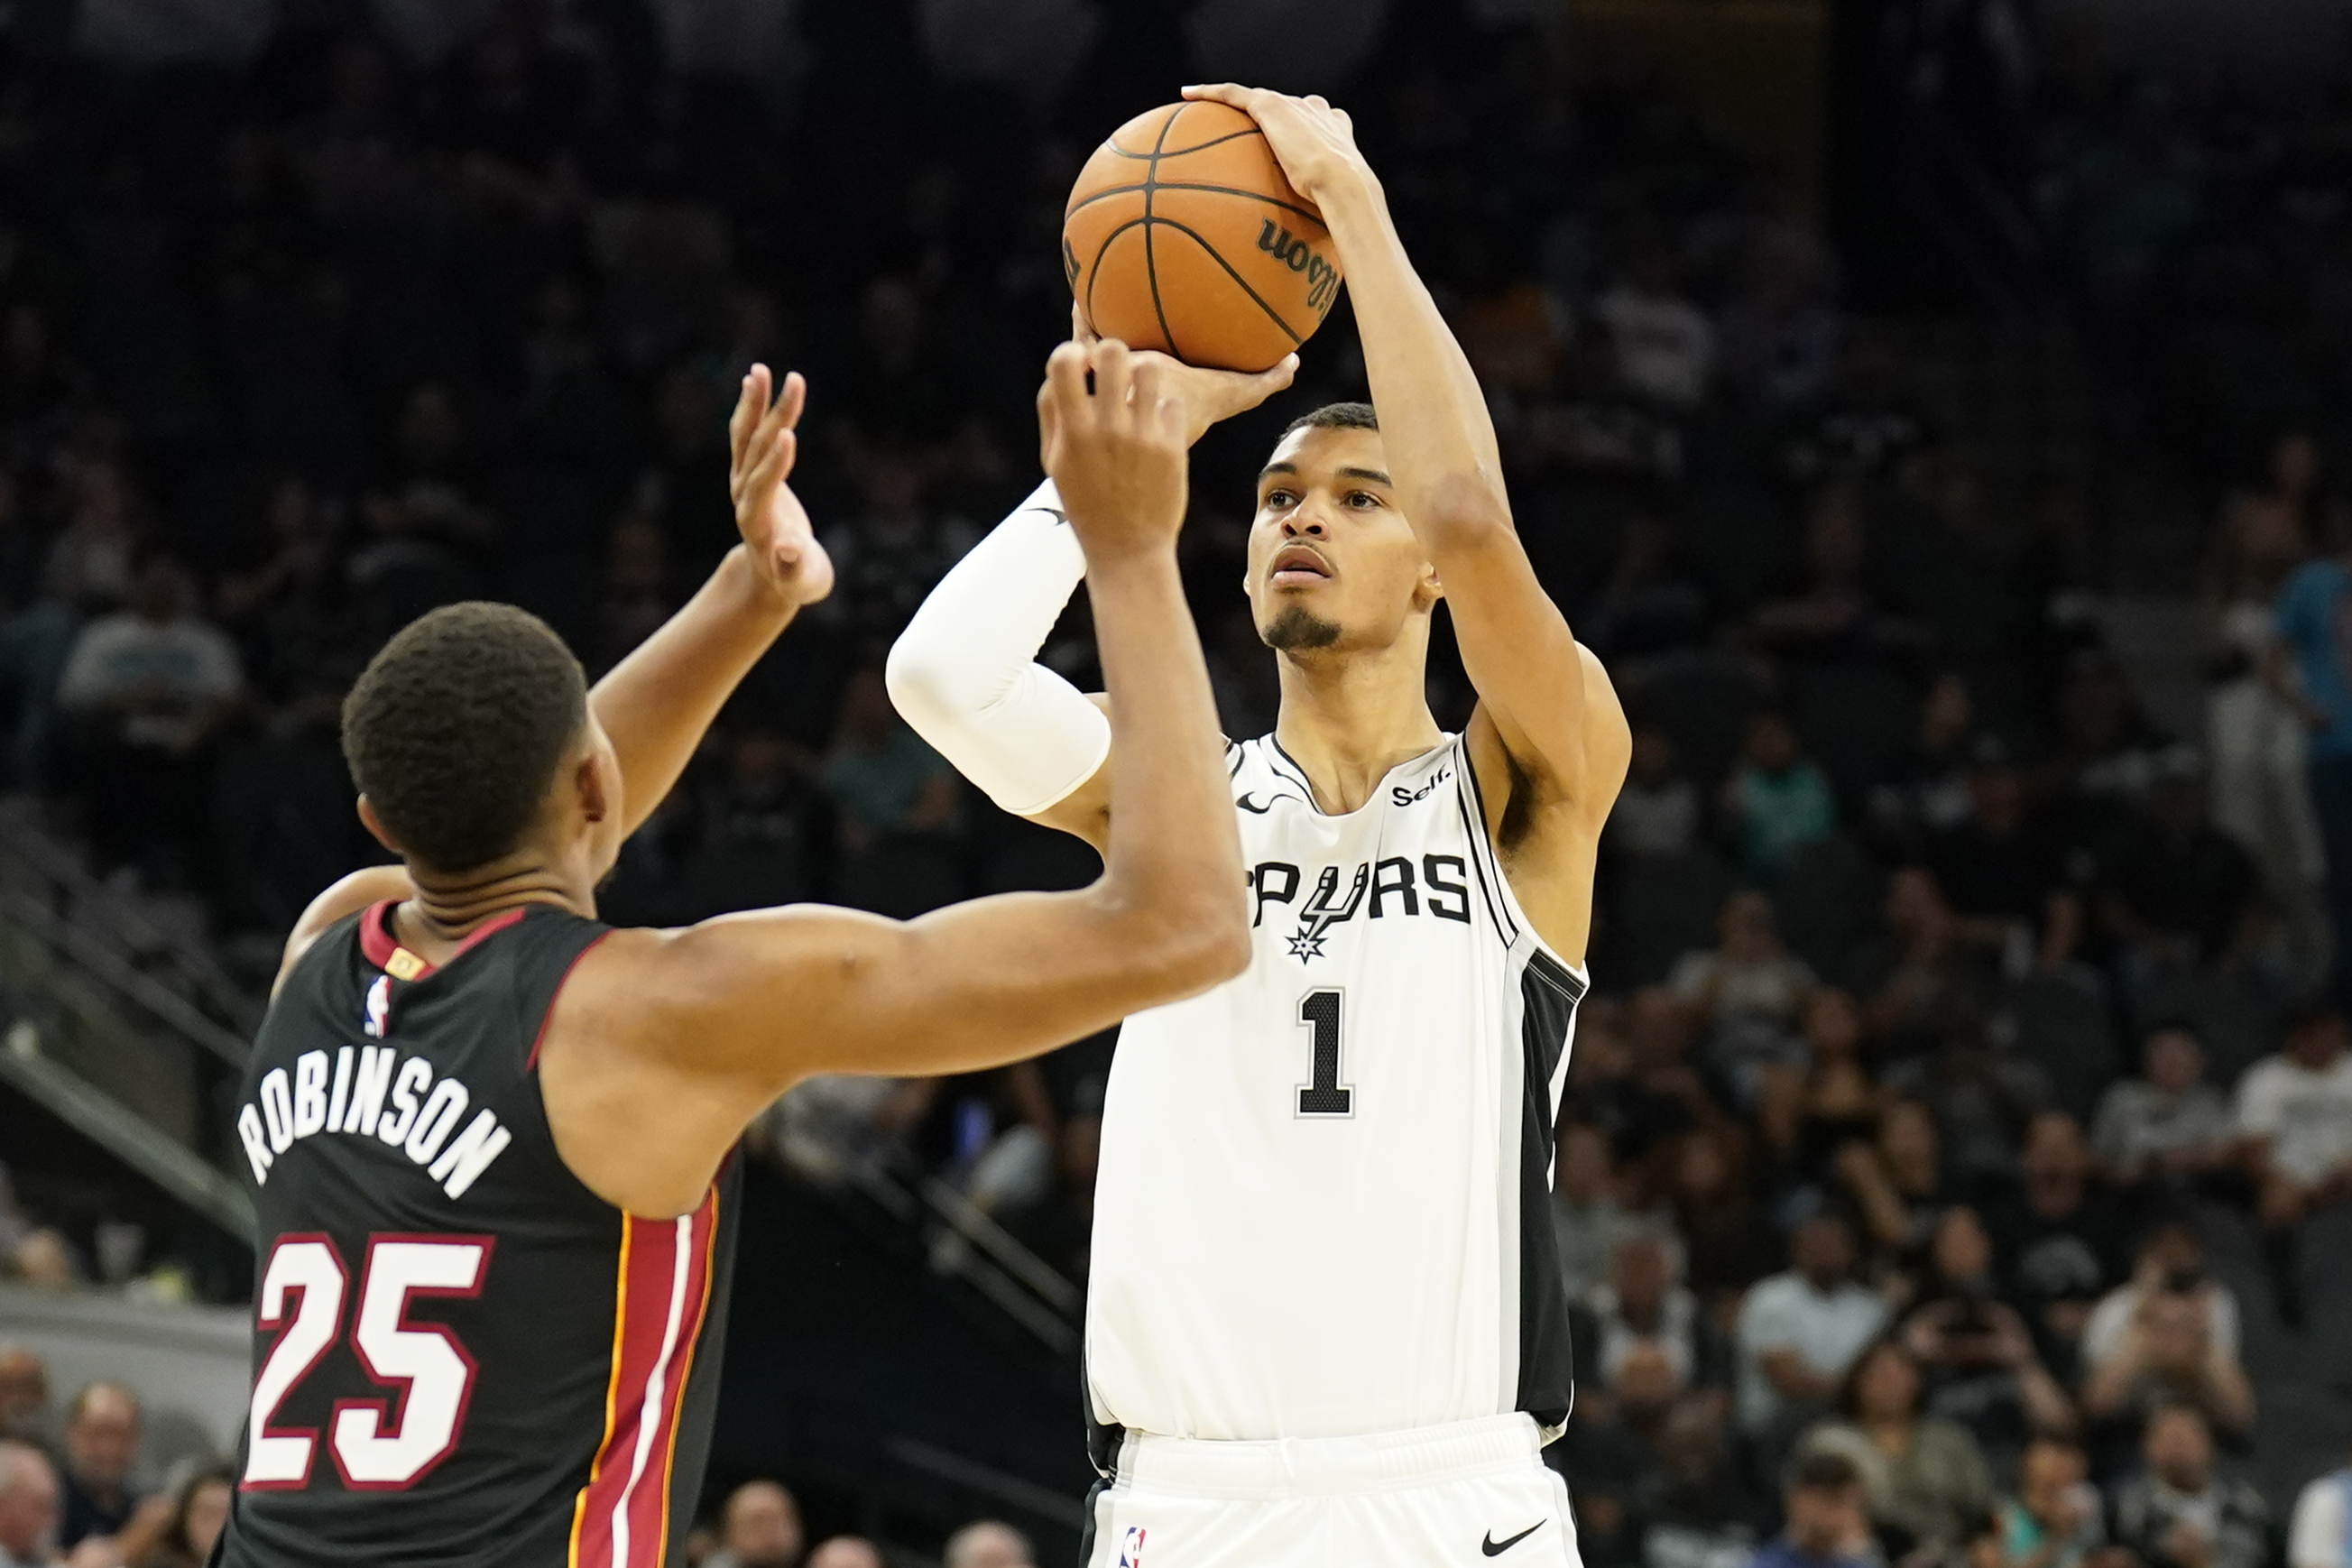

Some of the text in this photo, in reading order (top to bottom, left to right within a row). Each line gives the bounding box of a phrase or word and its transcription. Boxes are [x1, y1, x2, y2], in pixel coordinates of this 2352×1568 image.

[1256, 217, 1342, 324] ilson
[1245, 853, 1471, 929] PURS
[1294, 986, 1356, 1120] 1
[237, 1045, 512, 1201] ROBINSON
[239, 1231, 495, 1492] 25
